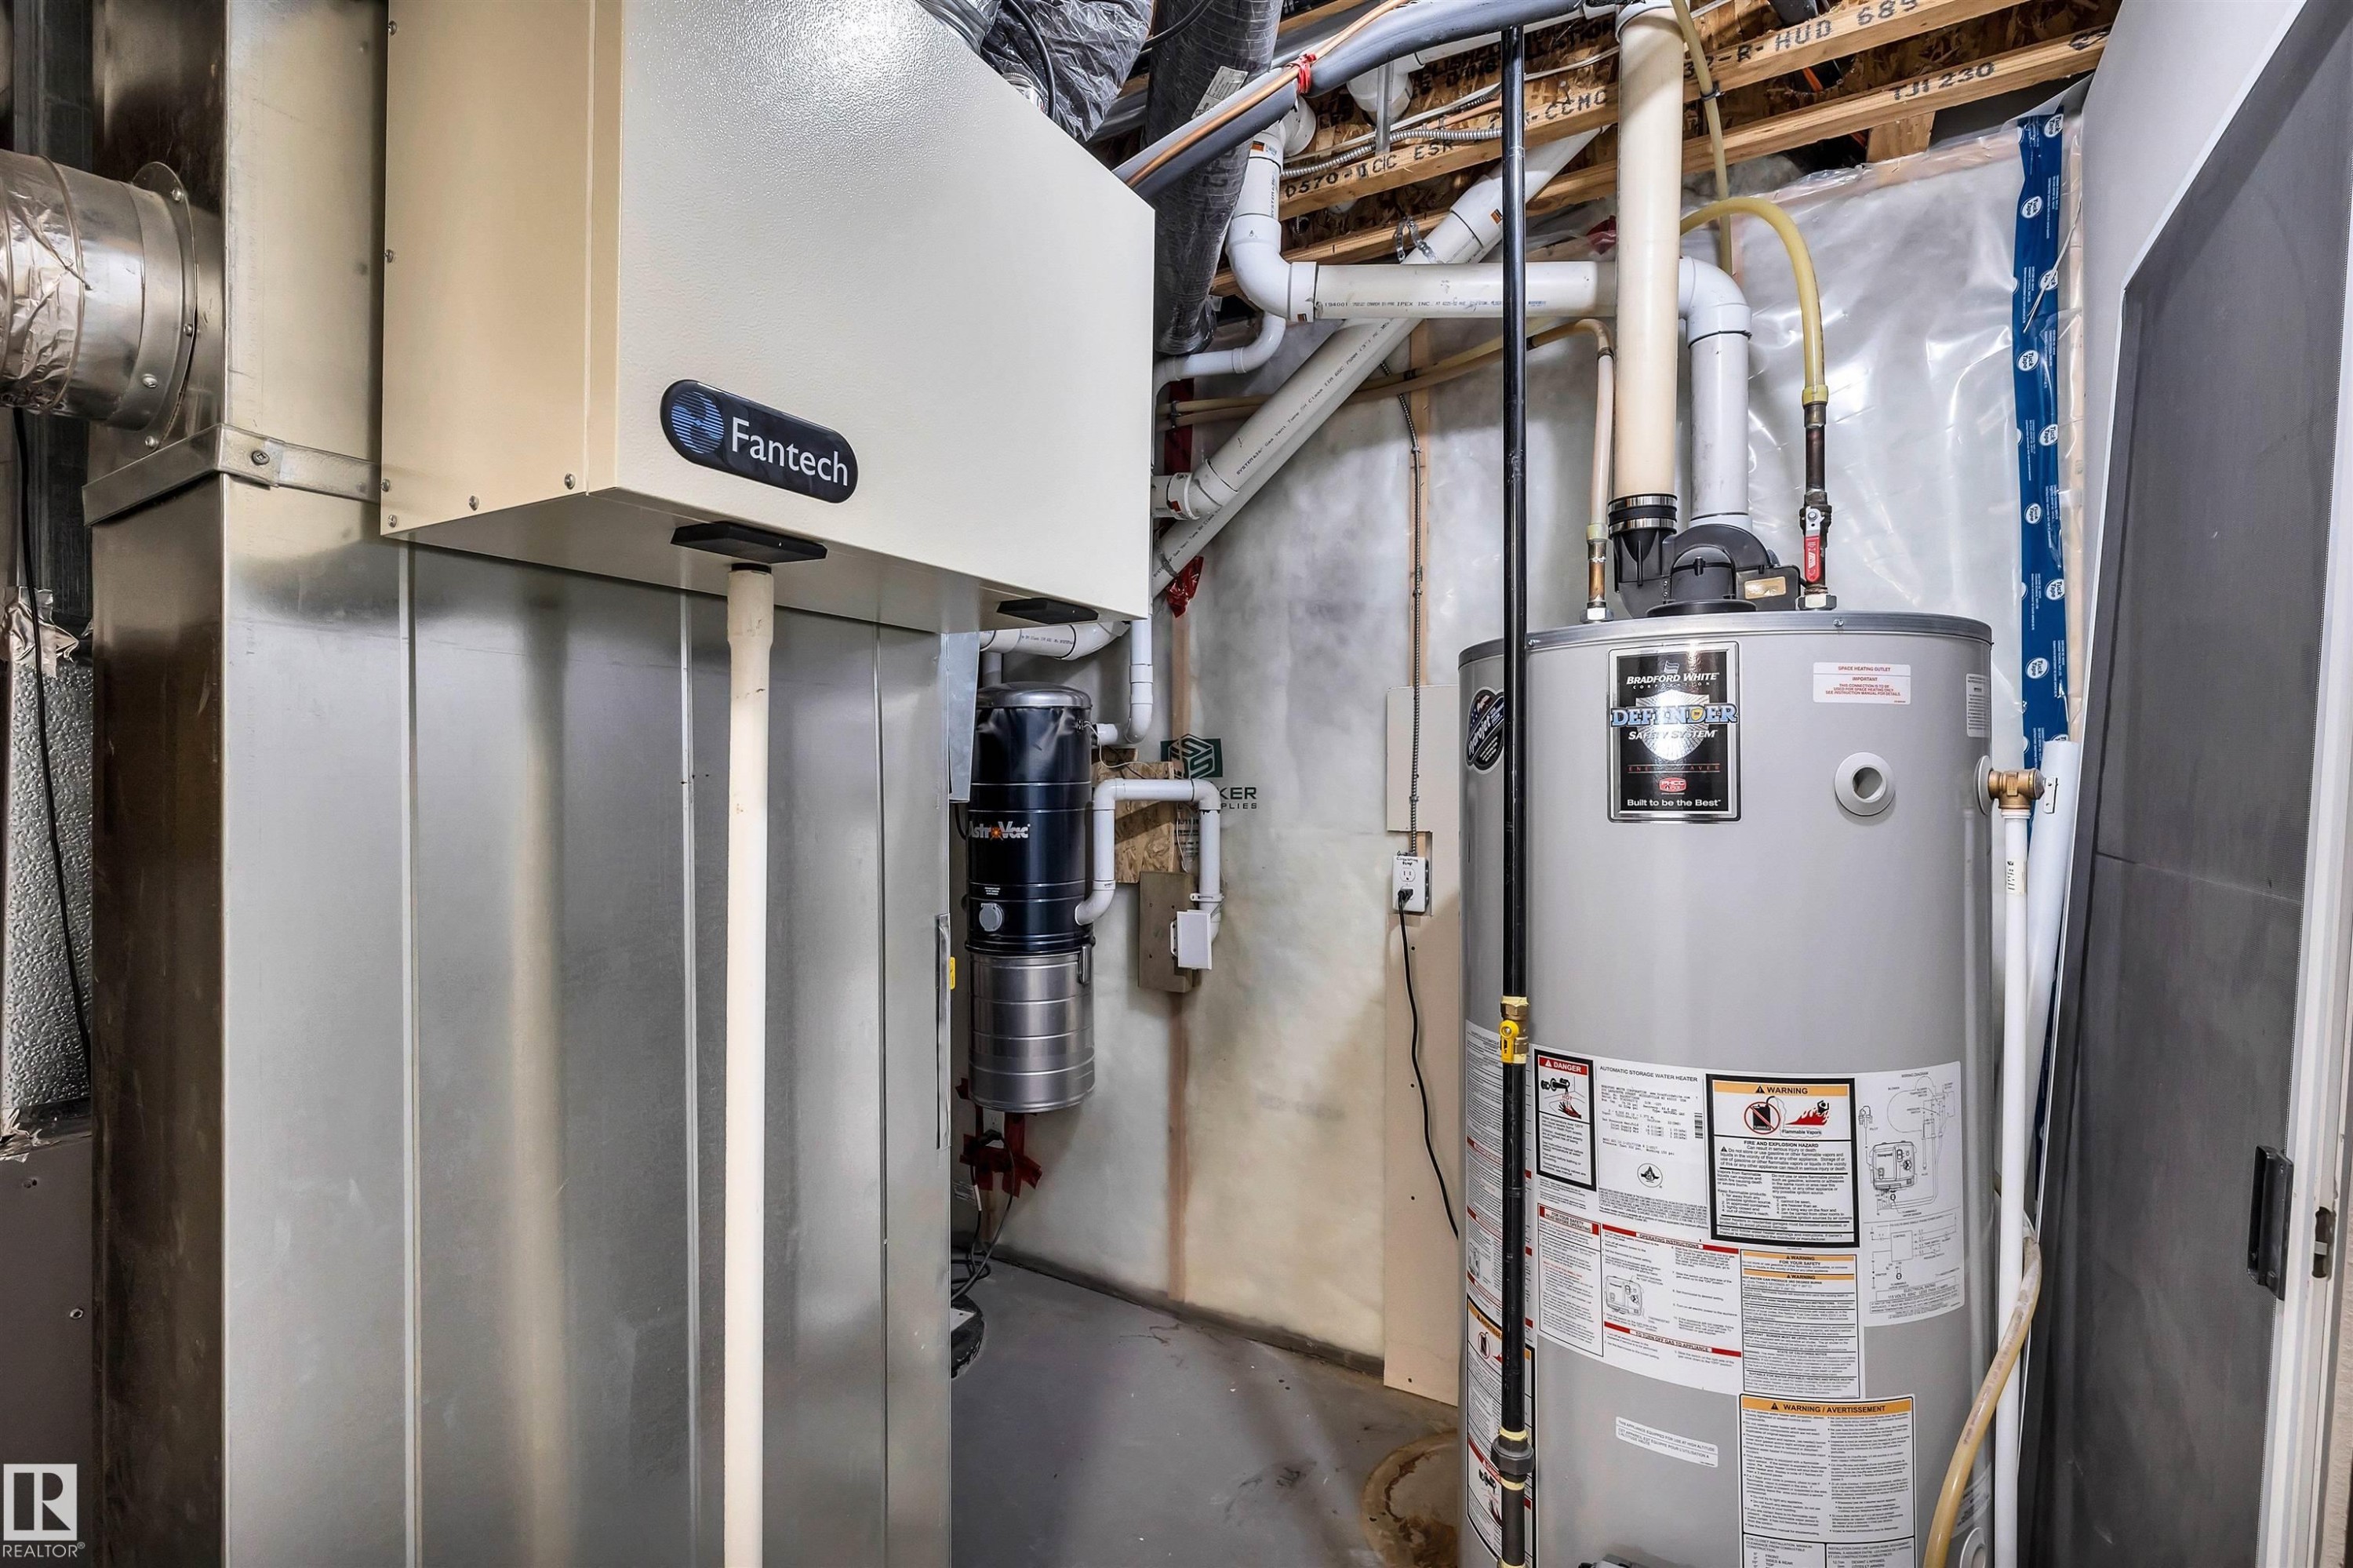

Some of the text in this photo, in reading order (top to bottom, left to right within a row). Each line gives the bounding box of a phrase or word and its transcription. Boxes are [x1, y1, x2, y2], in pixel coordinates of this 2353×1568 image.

[1775, 20, 1833, 51] HUD
[1937, 61, 1996, 89] 230
[731, 416, 848, 486] Fantech
[1626, 672, 1718, 685] BRADFORD WHITE
[1611, 704, 1738, 727] DEFENDER
[1554, 1061, 1581, 1072] DANGER
[1640, 1234, 1698, 1249] OPERATING INSTRUCTIONS
[1682, 1341, 1708, 1352] APPLIANCE
[1827, 1405, 1886, 1413] AVERTISSEMENT
